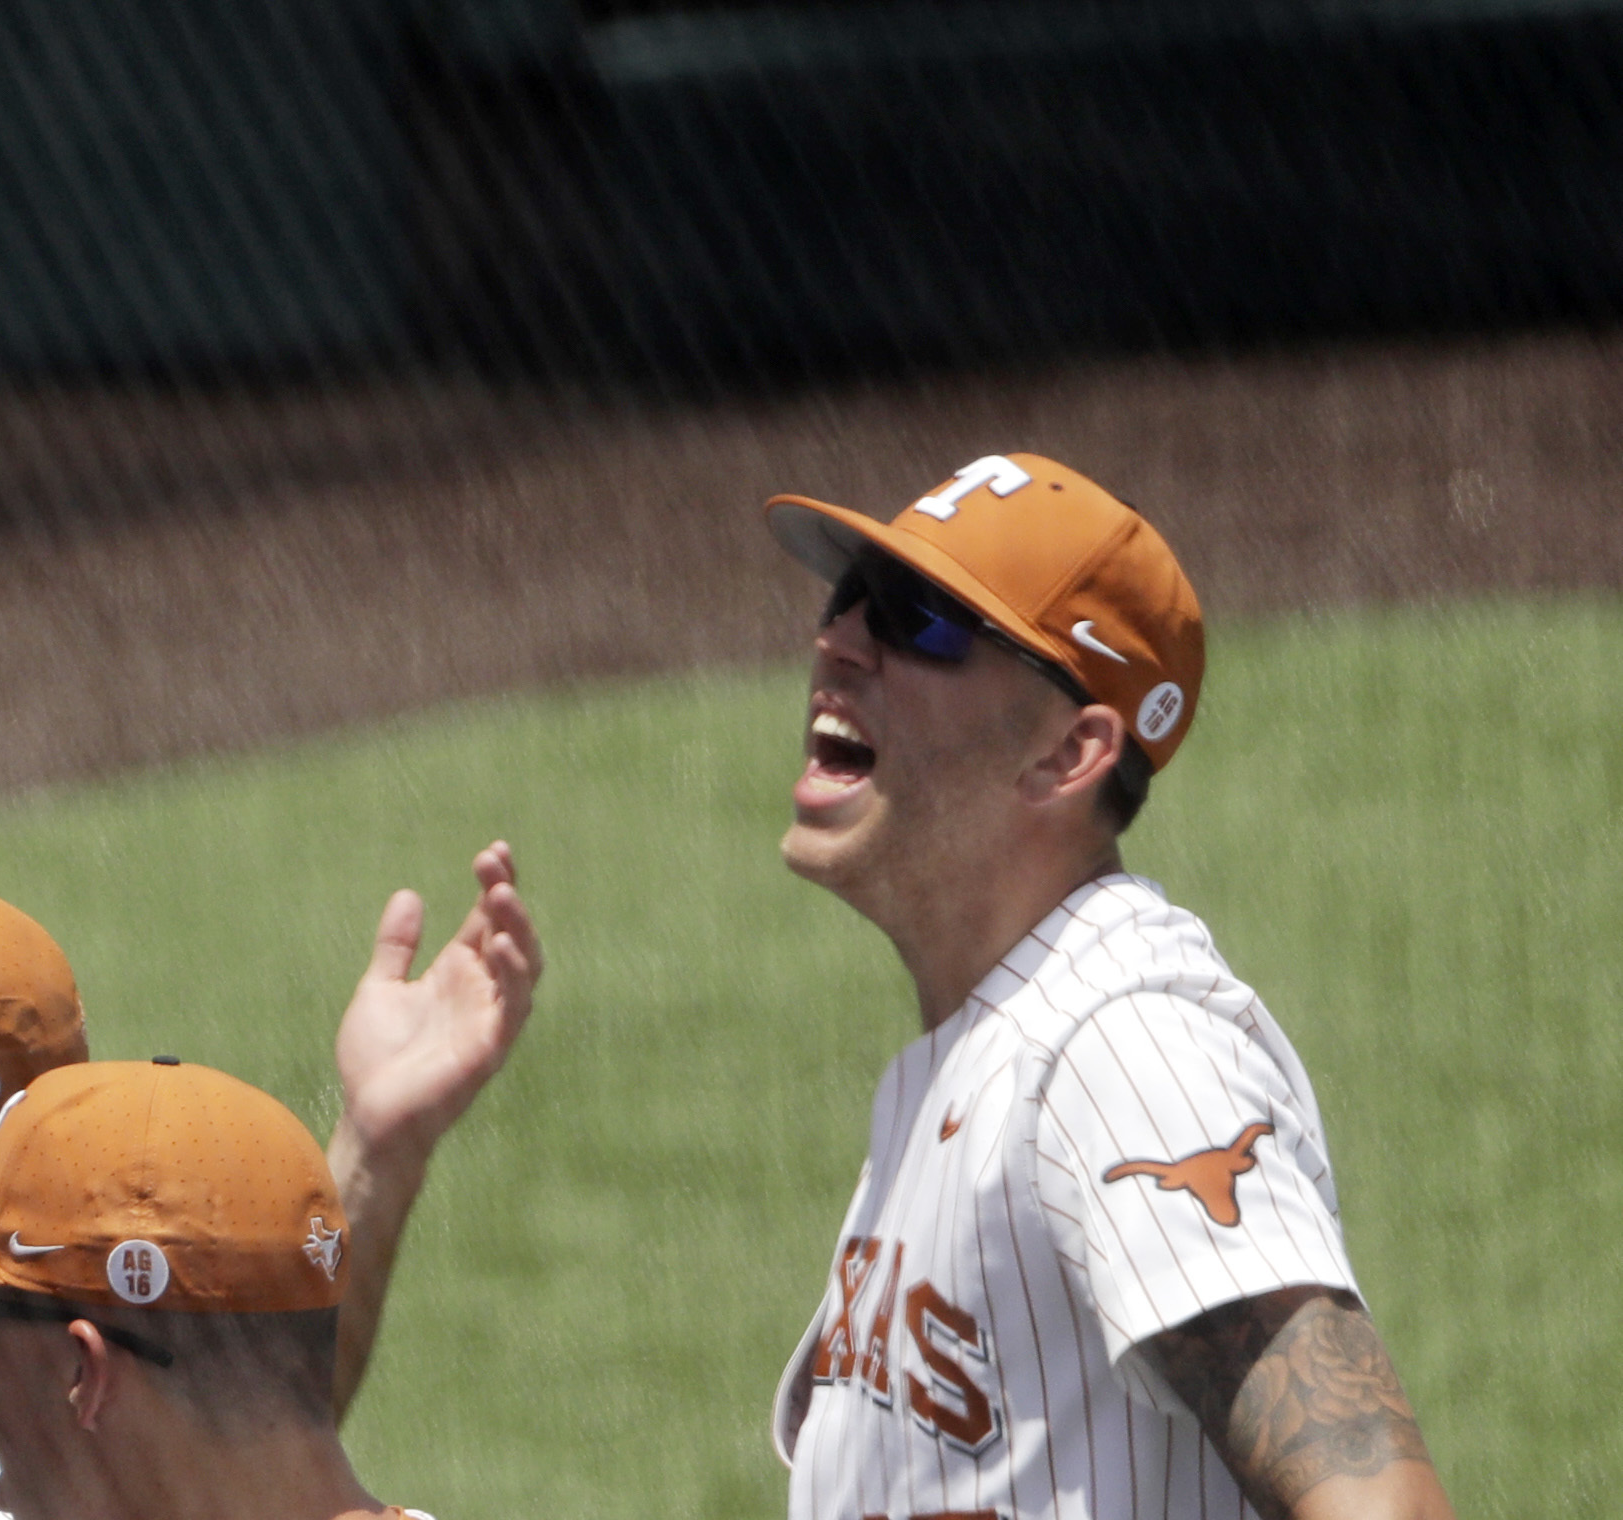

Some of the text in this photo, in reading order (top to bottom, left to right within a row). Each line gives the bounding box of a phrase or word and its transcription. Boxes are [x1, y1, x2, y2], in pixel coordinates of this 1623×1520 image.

[912, 454, 1032, 523] T
[1156, 689, 1178, 717] AG
[1144, 708, 1164, 733] 16
[122, 1248, 153, 1271] AG
[124, 1272, 152, 1297] 16
[812, 1236, 1004, 1459] XAS
